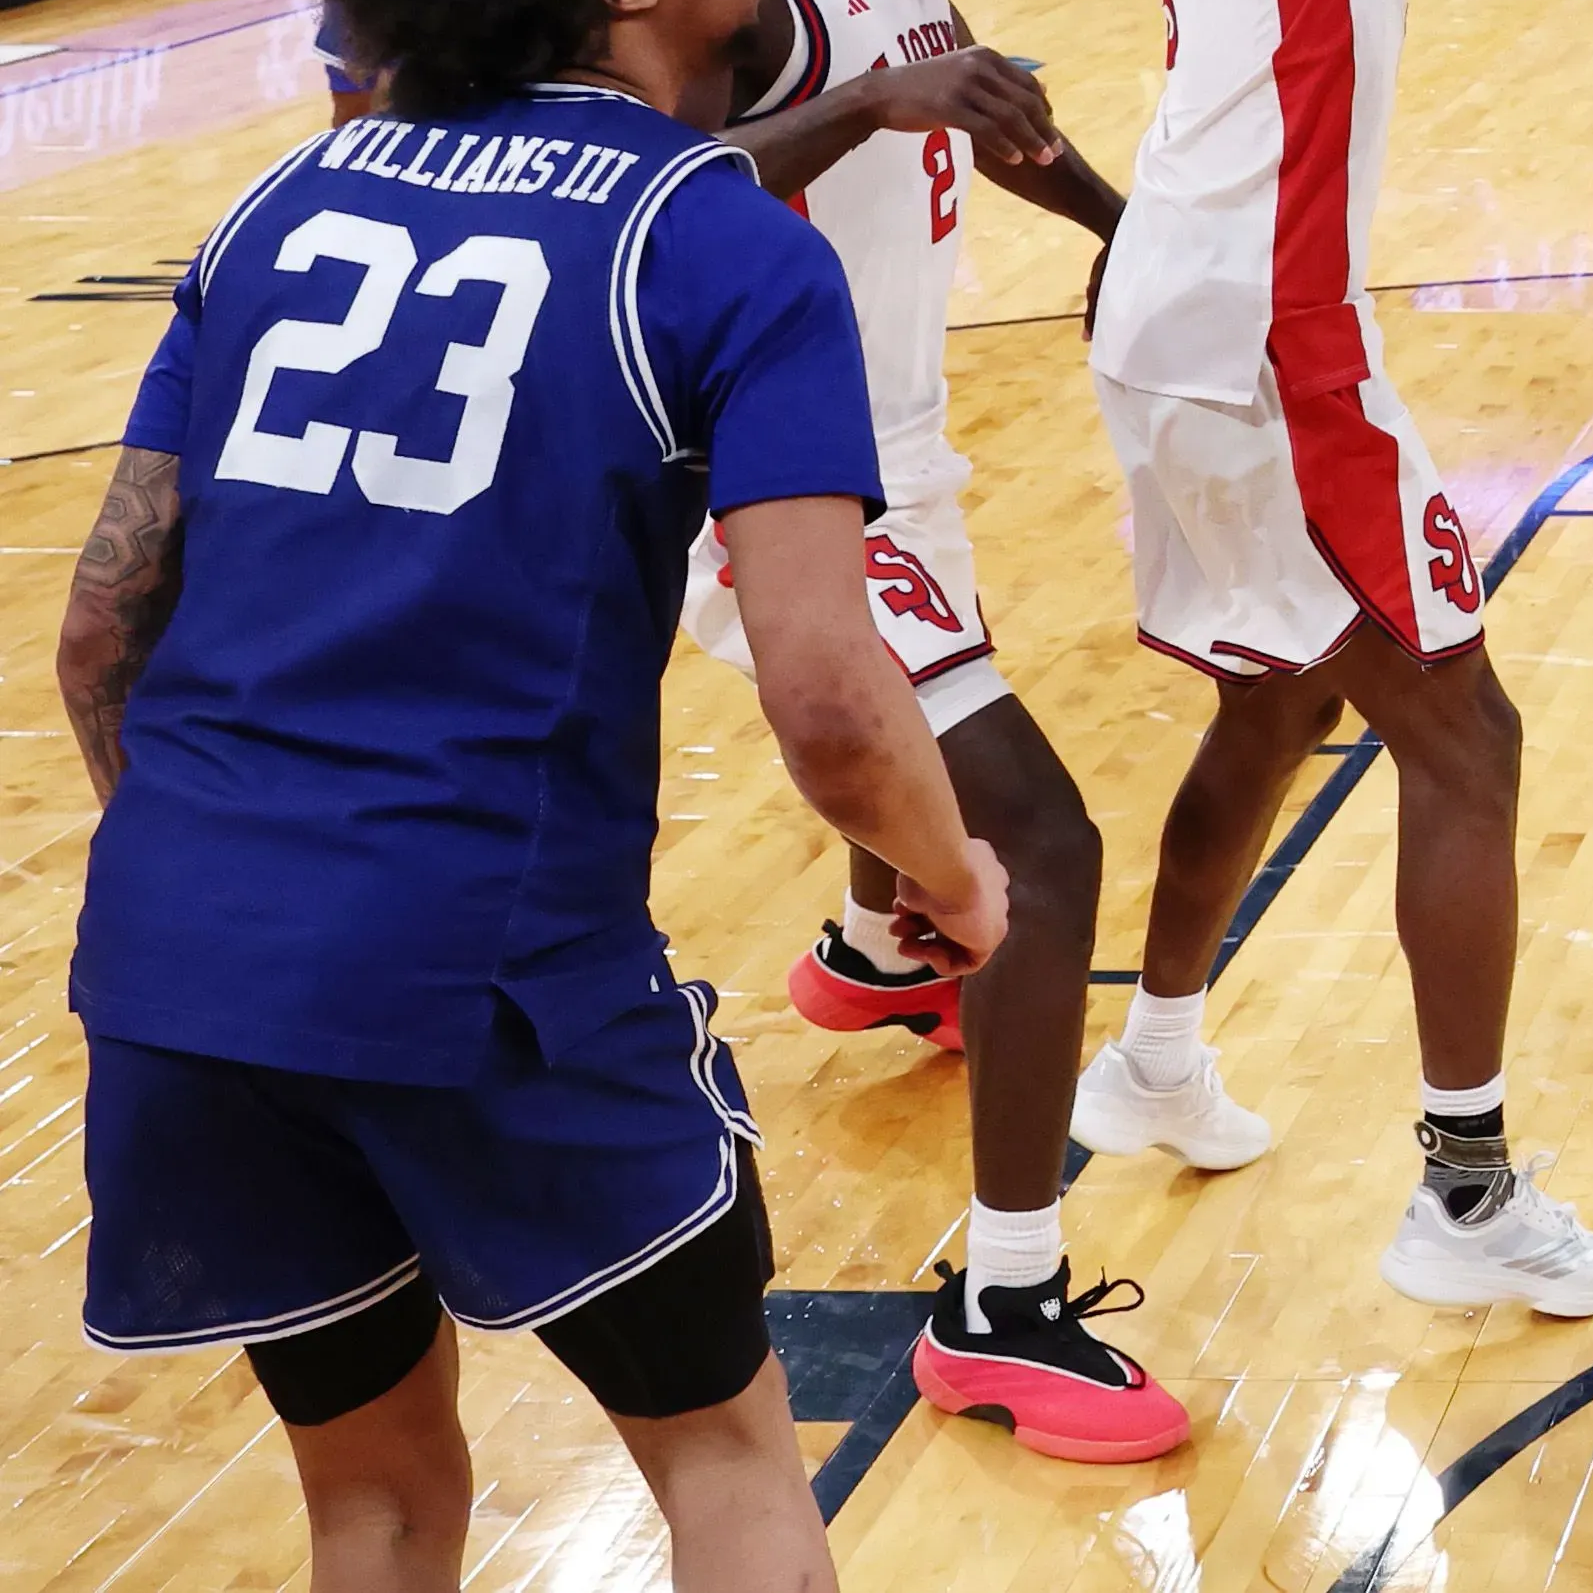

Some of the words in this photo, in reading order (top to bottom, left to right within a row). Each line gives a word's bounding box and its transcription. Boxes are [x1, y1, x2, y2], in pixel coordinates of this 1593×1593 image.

[318, 119, 575, 194] WILLIAMS
[551, 144, 640, 204] III
[923, 127, 958, 245] 2
[214, 209, 552, 515] 23
